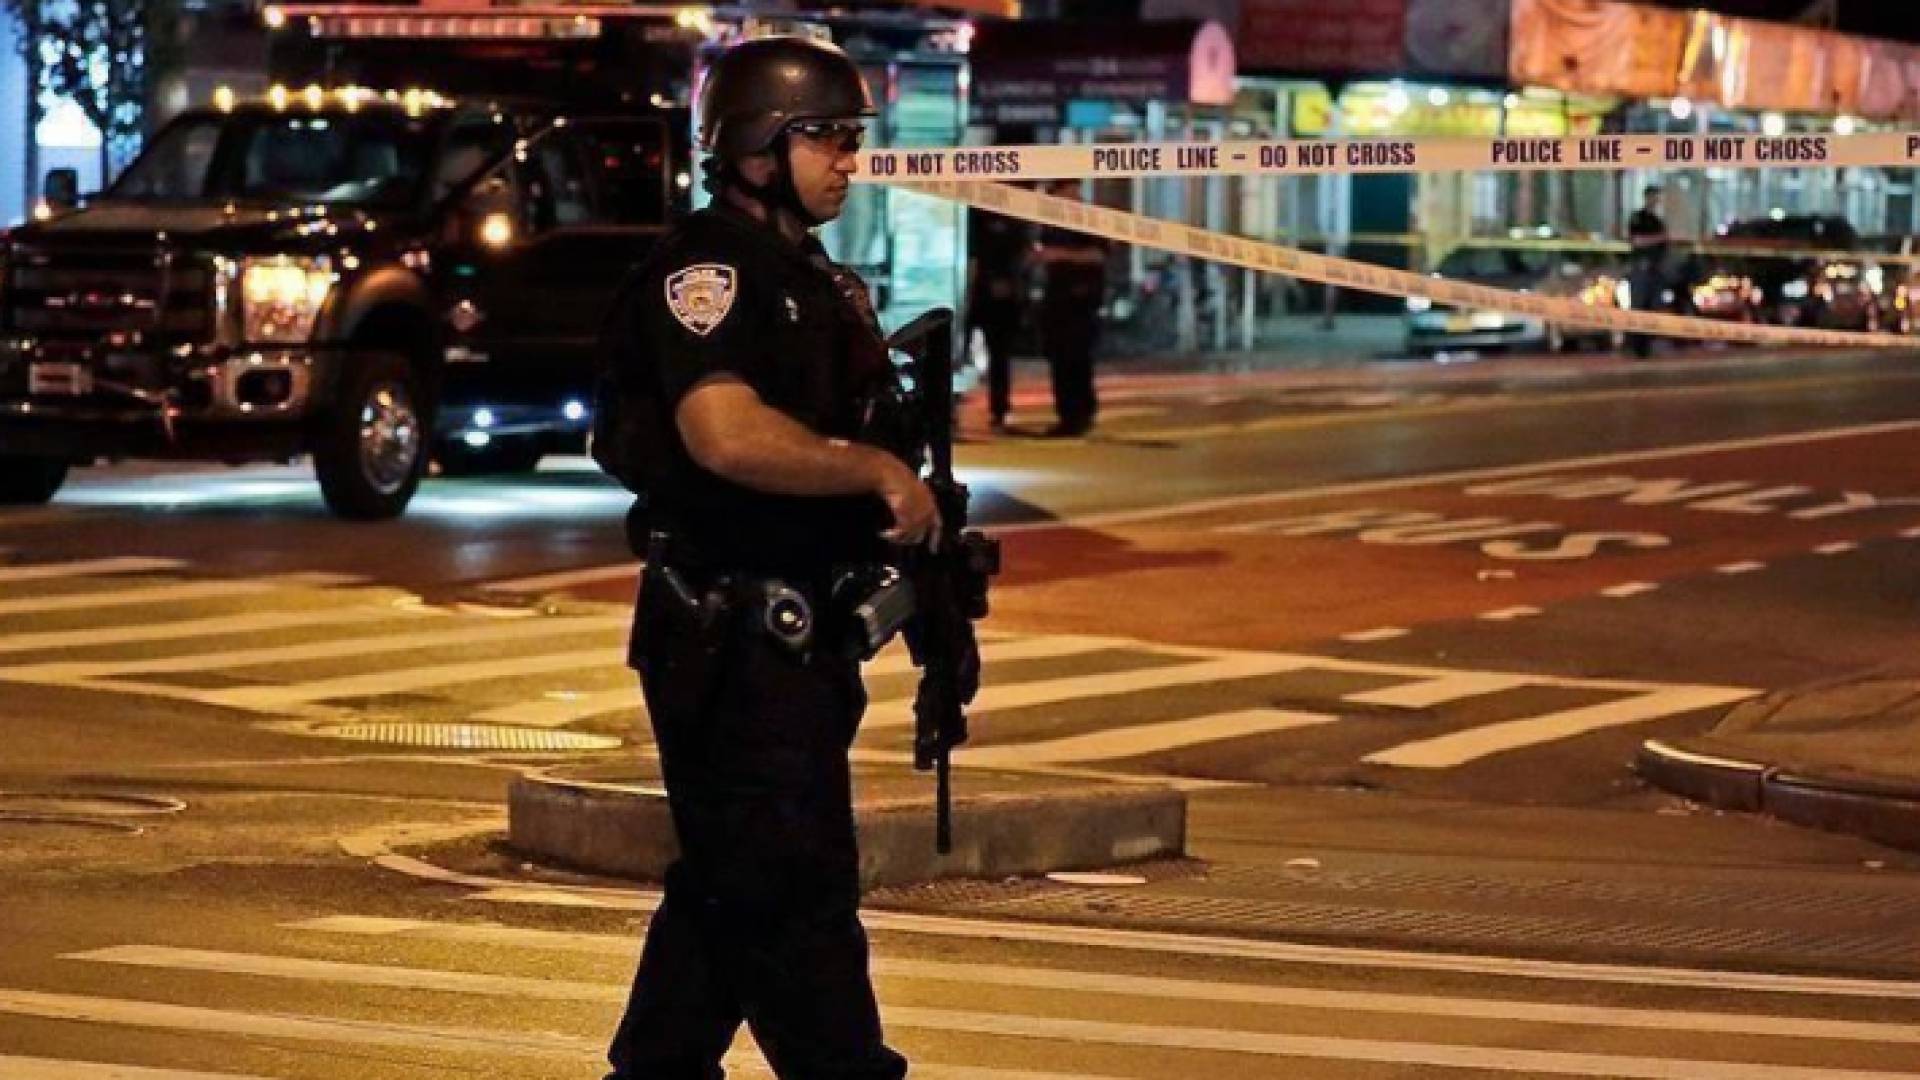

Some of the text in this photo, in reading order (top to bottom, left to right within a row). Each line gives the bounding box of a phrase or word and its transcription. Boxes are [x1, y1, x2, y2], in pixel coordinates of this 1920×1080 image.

[871, 154, 897, 175] DO
[907, 153, 945, 175] NOT
[954, 151, 1020, 174] CROSS
[1093, 148, 1161, 171] POLICE
[1177, 146, 1219, 169] LINE
[1260, 145, 1287, 168] DO
[1298, 144, 1337, 168] NOT
[1347, 143, 1416, 166] CROSS
[1492, 140, 1562, 163] POLICE
[1579, 140, 1622, 163] LINE
[1665, 140, 1694, 162] DO
[1703, 138, 1745, 161] NOT
[1755, 137, 1827, 161] CROSS
